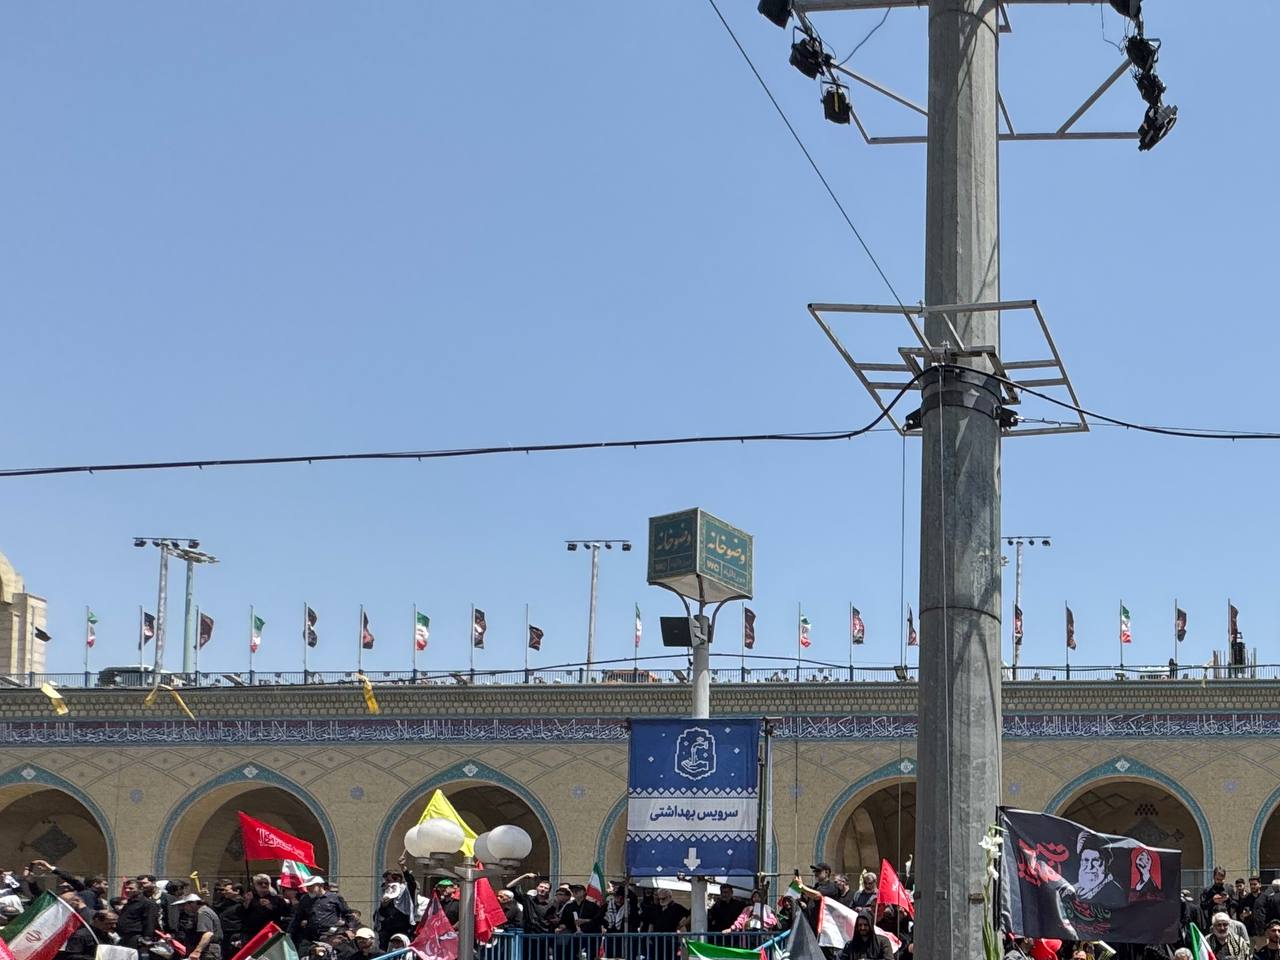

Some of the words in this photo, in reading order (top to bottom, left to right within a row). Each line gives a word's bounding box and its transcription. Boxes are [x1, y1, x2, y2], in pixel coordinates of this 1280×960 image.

[706, 531, 746, 565] وضوخانه
[650, 805, 696, 821] بهداشتی
[697, 809, 738, 821] سرویس
